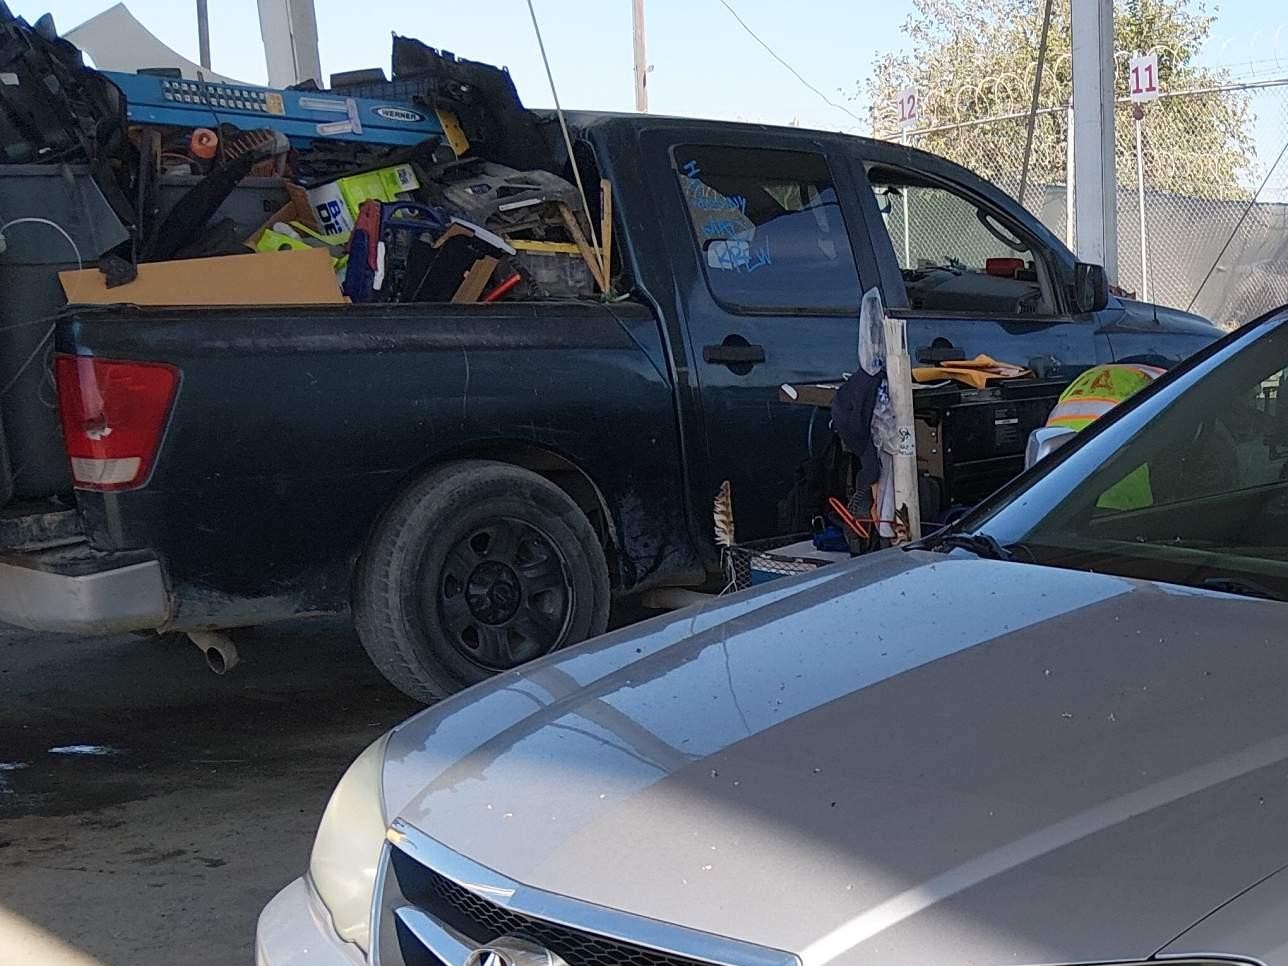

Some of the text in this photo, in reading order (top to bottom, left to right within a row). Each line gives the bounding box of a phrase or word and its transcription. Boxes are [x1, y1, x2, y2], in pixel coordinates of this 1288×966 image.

[1131, 64, 1157, 94] 11
[381, 109, 416, 120] WERNER
[898, 94, 917, 122] 12
